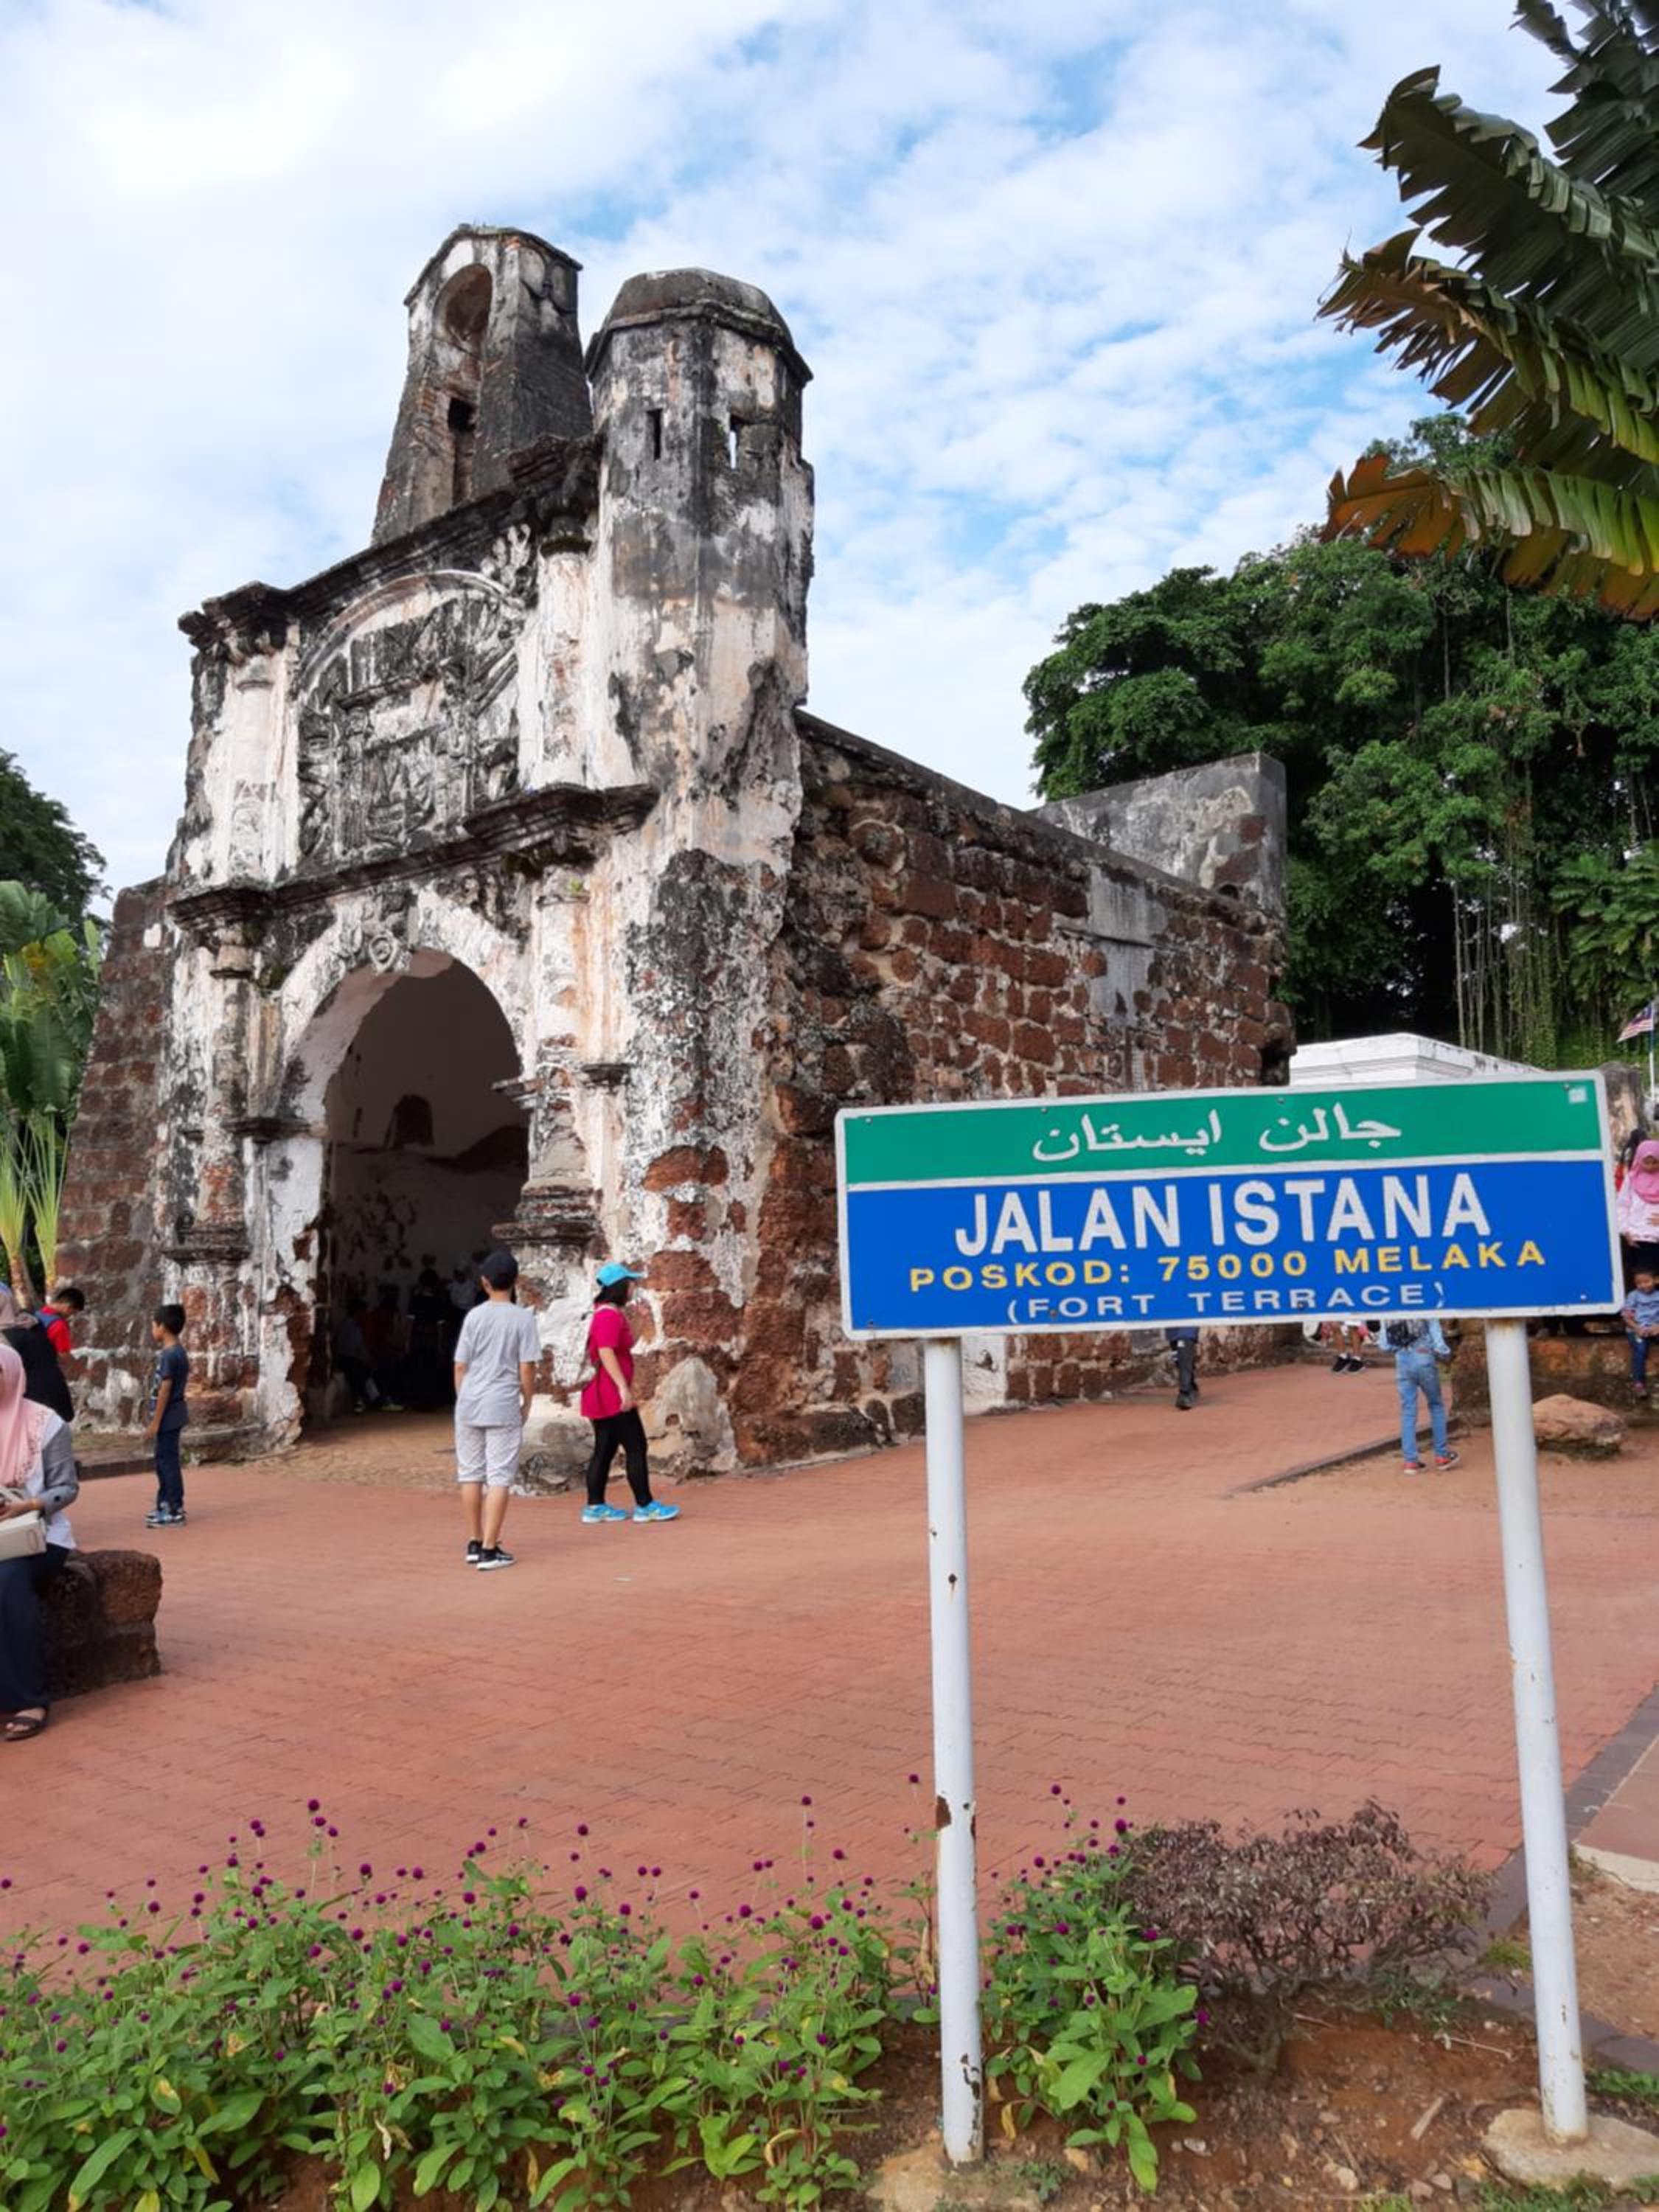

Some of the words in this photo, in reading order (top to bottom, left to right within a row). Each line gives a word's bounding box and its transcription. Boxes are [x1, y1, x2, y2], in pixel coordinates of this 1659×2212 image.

[1032, 1109, 1222, 1162] ايستان
[1259, 1103, 1402, 1152] جالن
[955, 1185, 1180, 1256] JALAN
[1208, 1173, 1491, 1245] ISTANA
[910, 1260, 1130, 1292] POSKOD:
[1158, 1251, 1307, 1281] 75000
[1334, 1240, 1545, 1274] MELAKA
[1007, 1295, 1155, 1324] (FORT
[1189, 1281, 1446, 1312] TERRACE)
